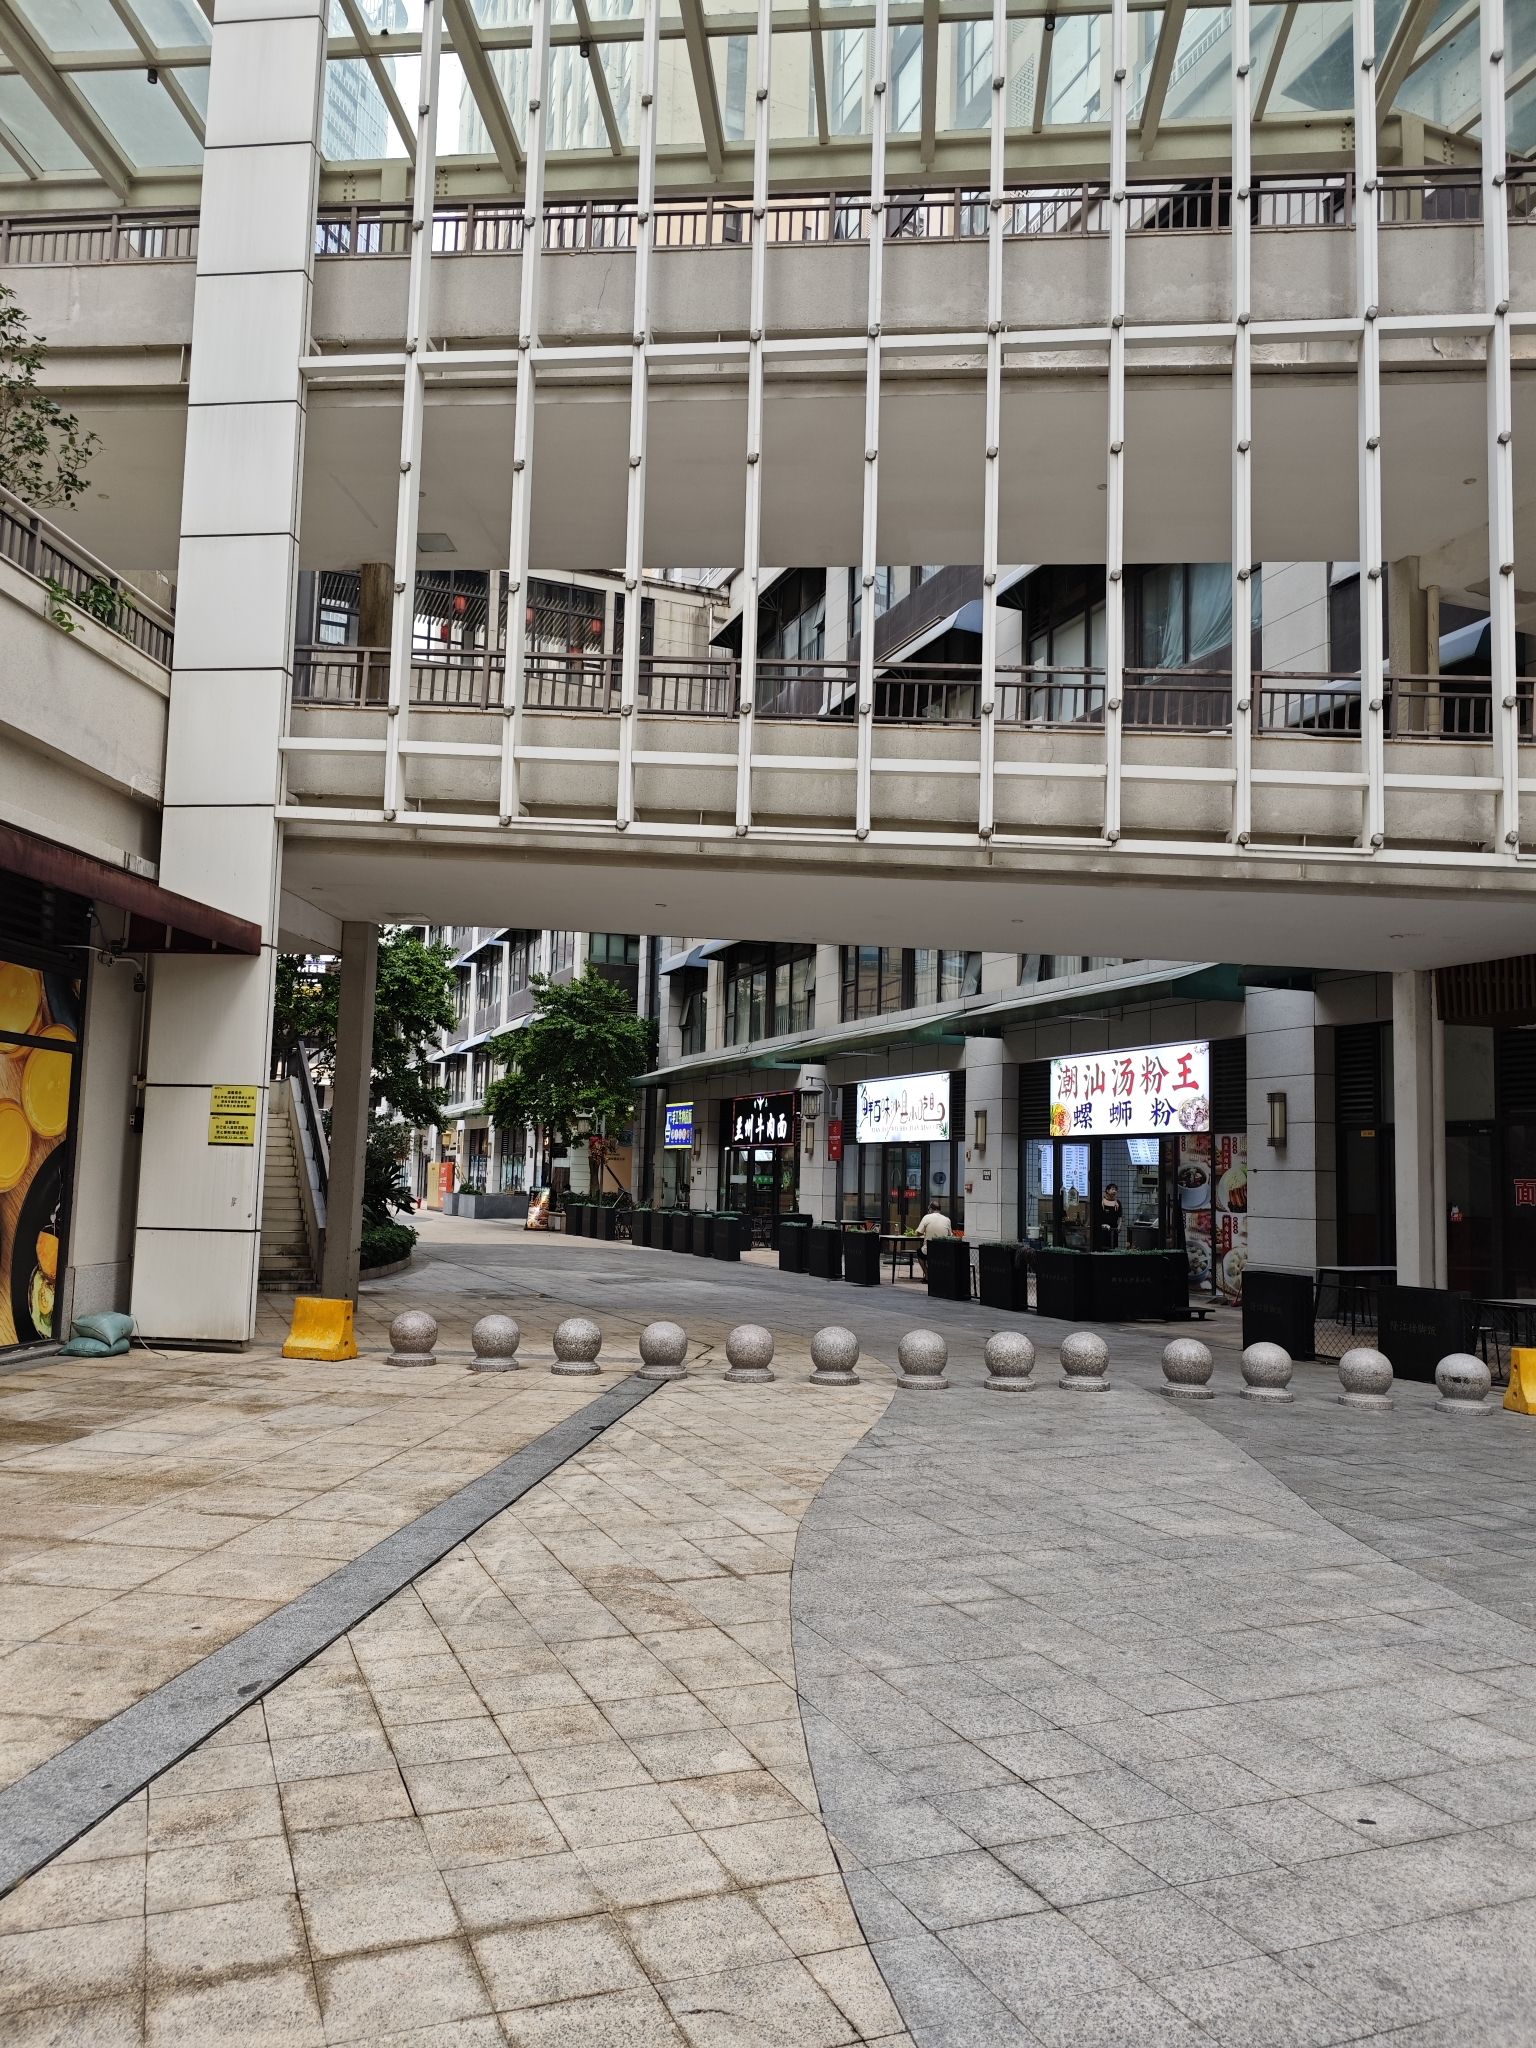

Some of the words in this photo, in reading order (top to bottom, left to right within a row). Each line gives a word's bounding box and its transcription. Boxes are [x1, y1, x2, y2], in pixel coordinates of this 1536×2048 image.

[1058, 1052, 1200, 1101] 潮汕汤粉王
[735, 1112, 788, 1143] 兰州牛肉面
[1073, 1097, 1179, 1130] 螺蛳粉
[1513, 1178, 1536, 1207] 面
